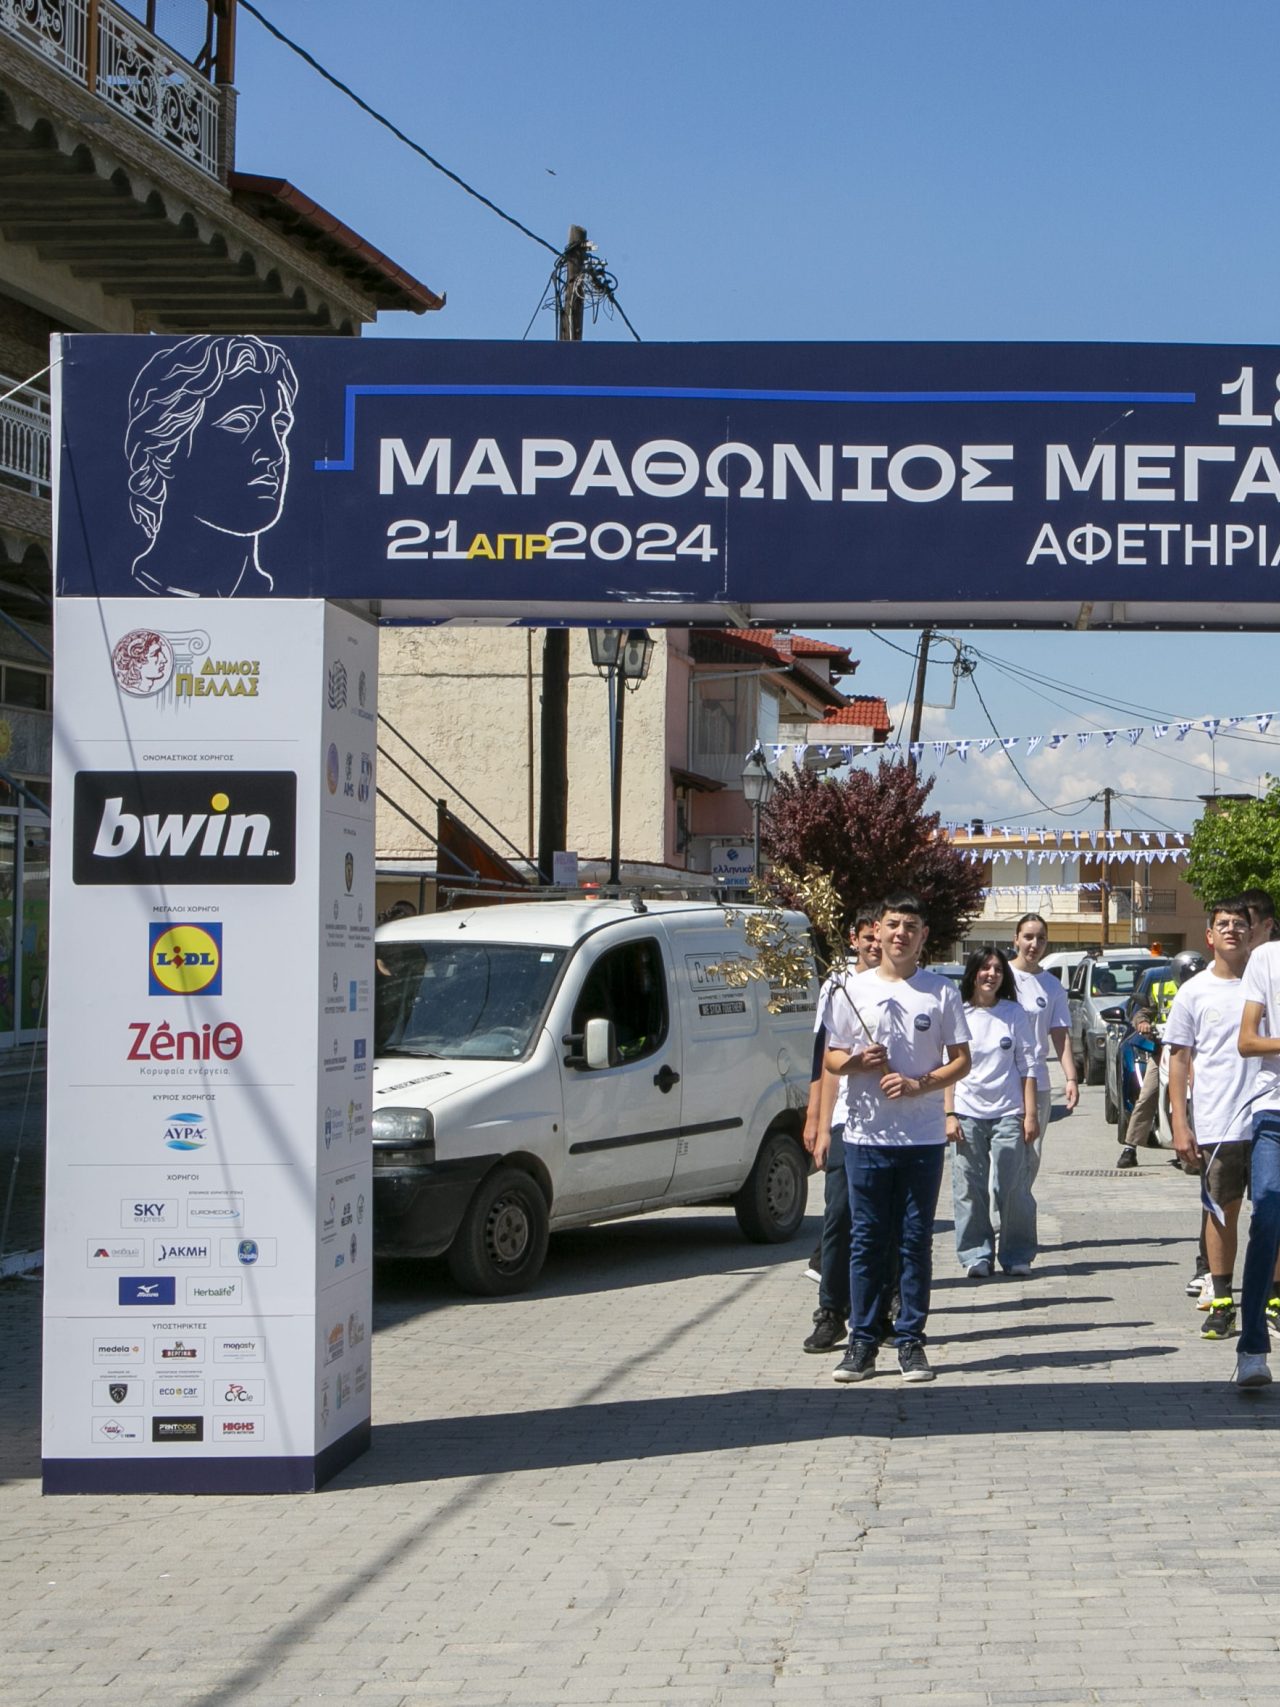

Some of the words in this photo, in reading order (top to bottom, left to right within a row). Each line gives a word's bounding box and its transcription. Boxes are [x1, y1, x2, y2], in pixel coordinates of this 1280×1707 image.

[379, 437, 1014, 503] ΜΑΡΑΘΩΝΙΟΣ
[200, 656, 261, 676] ΔΗΜΟΣ
[174, 673, 260, 696] ΠΕΛΛΑΣ
[142, 754, 198, 762] ΟΝΟΜΑΣΤΙΚΟΣ
[91, 792, 271, 858] bwin
[152, 905, 185, 913] ΜΕΓΑΛΟΙ
[187, 905, 220, 913] ΧΟΡΗΓΟΙ
[139, 1066, 185, 1076] Κορυφαία
[166, 1173, 200, 1181] ΧΟΡΗΓΟΙ
[134, 1203, 165, 1216] SKY
[134, 1215, 165, 1223] express
[168, 1246, 207, 1257] ΑΚΜΗ
[193, 1287, 232, 1297] Herbalife
[151, 1322, 207, 1330] ΥΠΟΣΤΗΡΙΚΤΕΣ
[98, 1345, 130, 1354] medela
[159, 1387, 176, 1397] eco
[183, 1386, 198, 1397] car
